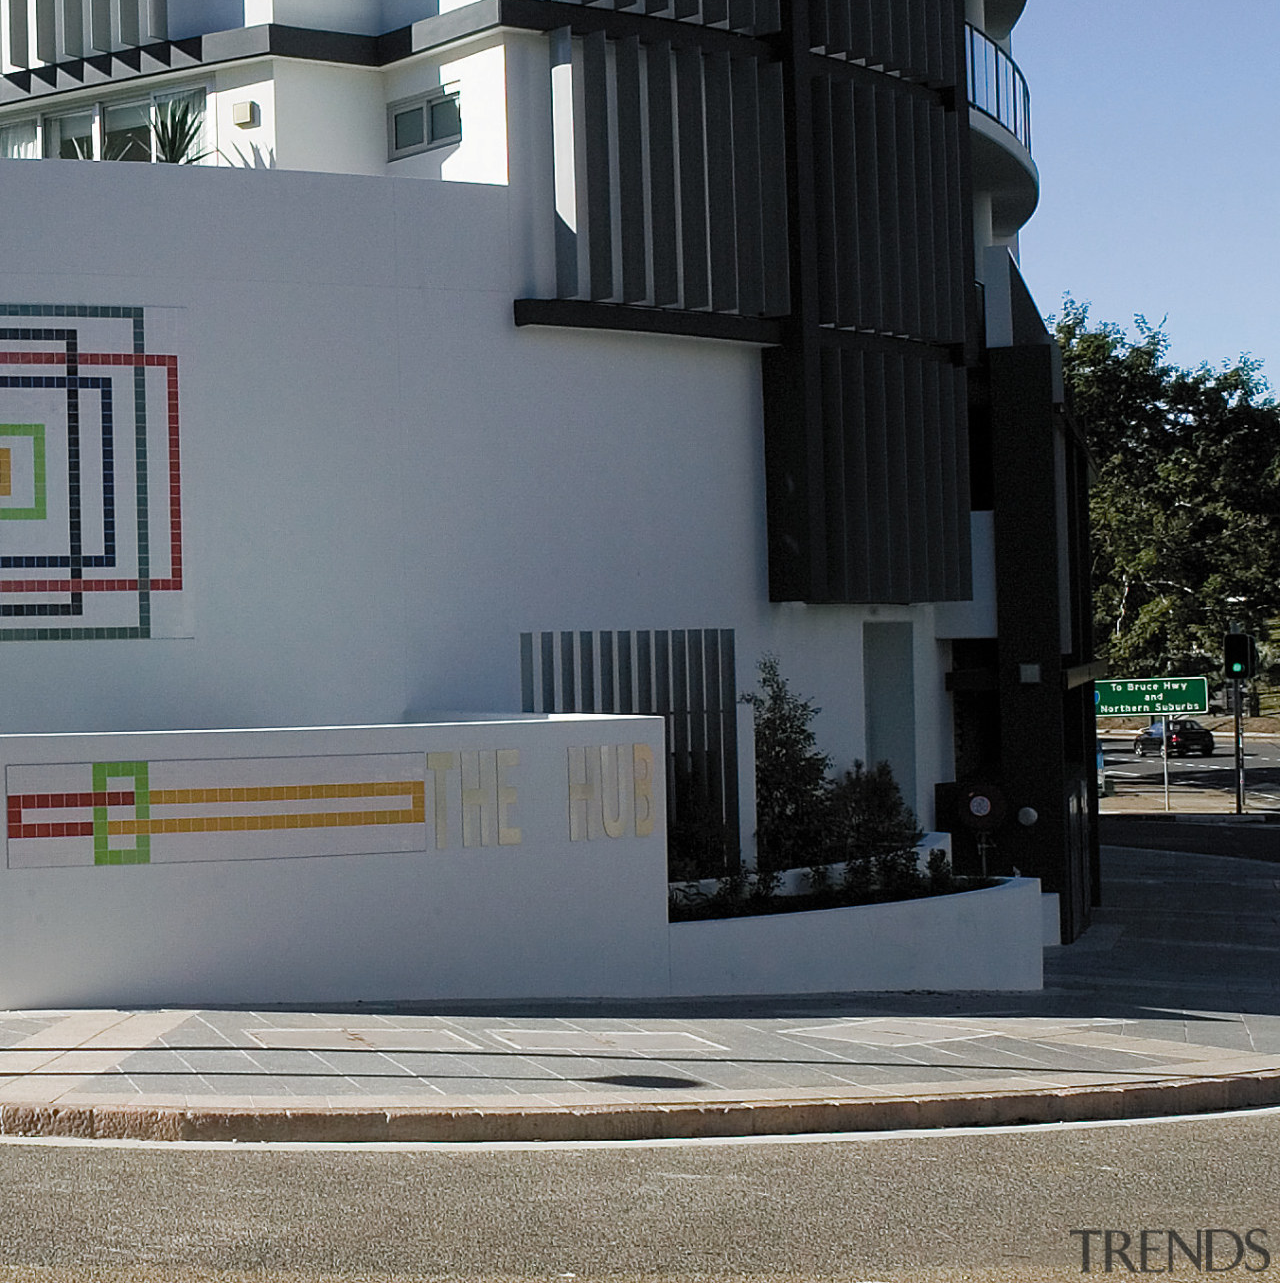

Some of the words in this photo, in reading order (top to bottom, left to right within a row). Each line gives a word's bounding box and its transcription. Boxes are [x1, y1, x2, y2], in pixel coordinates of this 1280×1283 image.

[1110, 683, 1122, 691] To
[1127, 683, 1159, 691] Bruce
[1163, 681, 1188, 691] Hwy
[1144, 693, 1163, 701] and
[1100, 704, 1150, 713] Northern
[1154, 702, 1200, 712] Suburbs
[426, 749, 522, 849] THE
[567, 743, 656, 842] HUB
